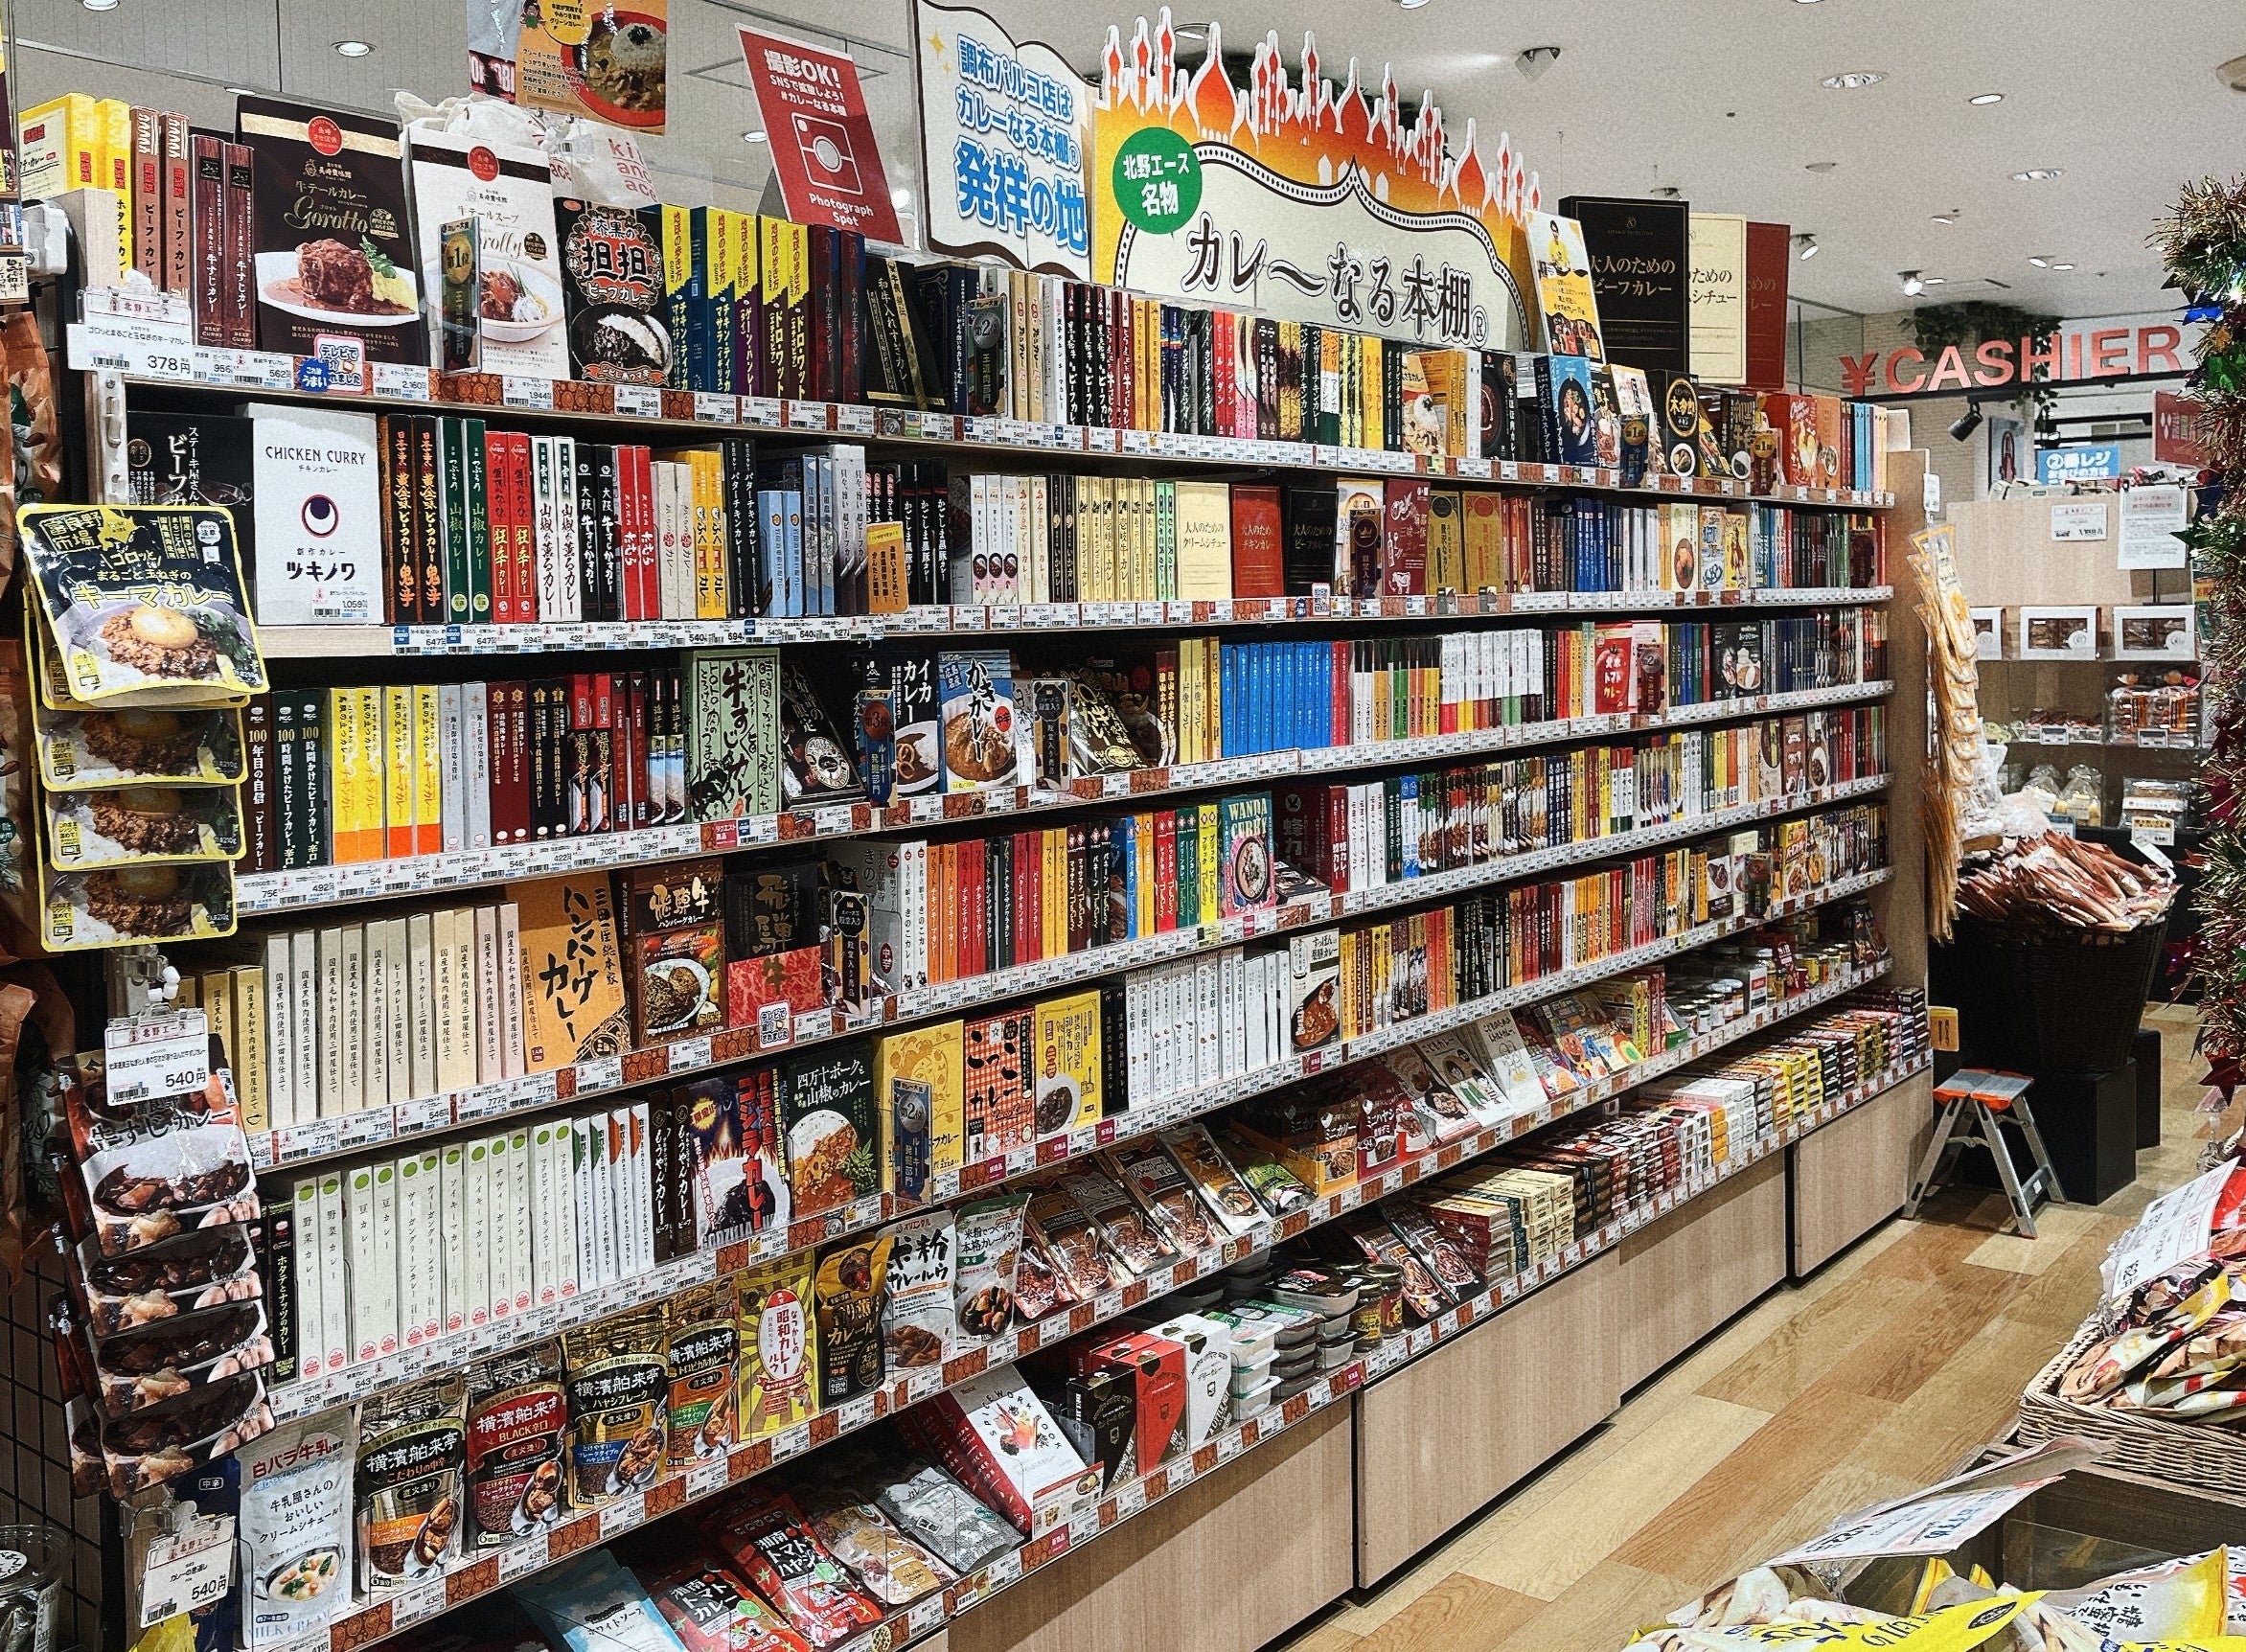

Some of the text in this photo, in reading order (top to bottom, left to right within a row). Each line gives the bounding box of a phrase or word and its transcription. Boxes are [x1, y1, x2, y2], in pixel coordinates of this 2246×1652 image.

[958, 33, 1074, 123] 調布パルコ店は
[1123, 151, 1190, 178] 北野エース
[296, 180, 367, 199] 牛テールカレー
[952, 139, 1089, 255] 発祥の地
[1142, 183, 1180, 216] 名物
[284, 195, 368, 232] Gorotto
[458, 206, 520, 224] 牛テールスープ
[809, 192, 875, 218] Photograph
[833, 209, 860, 228] Spot
[591, 218, 634, 240] 漆黒の
[582, 241, 654, 287] 担担
[1589, 257, 1676, 275] 大人のための
[586, 282, 651, 305] ビーフカレー
[1592, 278, 1672, 296] ビーフカレー
[1688, 290, 1737, 305] シチュー
[124, 302, 170, 315] 北野エース
[320, 344, 359, 360] テレビで
[1885, 325, 2181, 394] CASHIER
[302, 376, 328, 387] うまい
[265, 447, 366, 465] CHICKEN CURRY
[731, 471, 743, 560] バターチキンカレー
[745, 472, 755, 554] バターチキンカレー
[449, 502, 464, 570] 山椒カレー
[470, 502, 487, 570] 山椒カレー
[97, 569, 192, 581] まるごと玉ねぎの
[286, 561, 355, 582] ツキノワ
[493, 528, 509, 594] 狂辛カレー
[515, 528, 531, 594] 狂辛カレー
[72, 584, 234, 609] キーマカレー
[903, 660, 917, 723] カレー
[918, 659, 932, 703] イカ
[966, 657, 996, 763] かきカレー
[1227, 798, 1267, 815] WANDA
[649, 876, 710, 920] 飛騨牛
[562, 884, 598, 1005] ハンバーグ
[539, 952, 577, 1043] カレー
[143, 1024, 186, 1037] 北野エース
[797, 1059, 865, 1090] 四万十ポークと
[807, 1078, 871, 1107] 山椒のカレー
[89, 1110, 235, 1150] 牛すじカレー
[358, 1203, 368, 1256] 豆カレー
[381, 1198, 391, 1250] 豆カレー
[449, 1179, 459, 1265] ソイキーマカレー
[474, 1175, 485, 1258] ソイキーマカレー
[302, 1216, 313, 1288] 野菜カレー
[326, 1208, 337, 1280] 野菜カレー
[960, 1230, 1016, 1254] 本格カレールウ
[276, 1255, 288, 1357] ホタテとナッツのカレー
[776, 1308, 789, 1381] 昭和カレー
[791, 1310, 800, 1354] なつかしの
[676, 1352, 728, 1374] トロピカルカレー
[769, 1353, 779, 1374] ルウ
[576, 1369, 659, 1398] 横濱舶来亭
[591, 1388, 649, 1409] ハヤシフレーク
[479, 1395, 559, 1435] 横濱舶来亭
[607, 1409, 638, 1424] 直火造り
[498, 1419, 550, 1444] BLACK辛口
[252, 1439, 334, 1477] 白バラ牛乳
[365, 1431, 459, 1473] 横濱舶来亭
[200, 1478, 223, 1489] 中辛
[386, 1458, 446, 1483] こだわりの中辛
[269, 1479, 334, 1513] 牛乳屋さんの
[285, 1500, 325, 1524] おいしい
[755, 1532, 789, 1549] 湘南
[767, 1538, 808, 1565] トマト
[670, 1583, 704, 1600] 湘南
[682, 1584, 727, 1609] トマト
[587, 1608, 645, 1635] ホワイトソース
[695, 1595, 738, 1622] カレー
